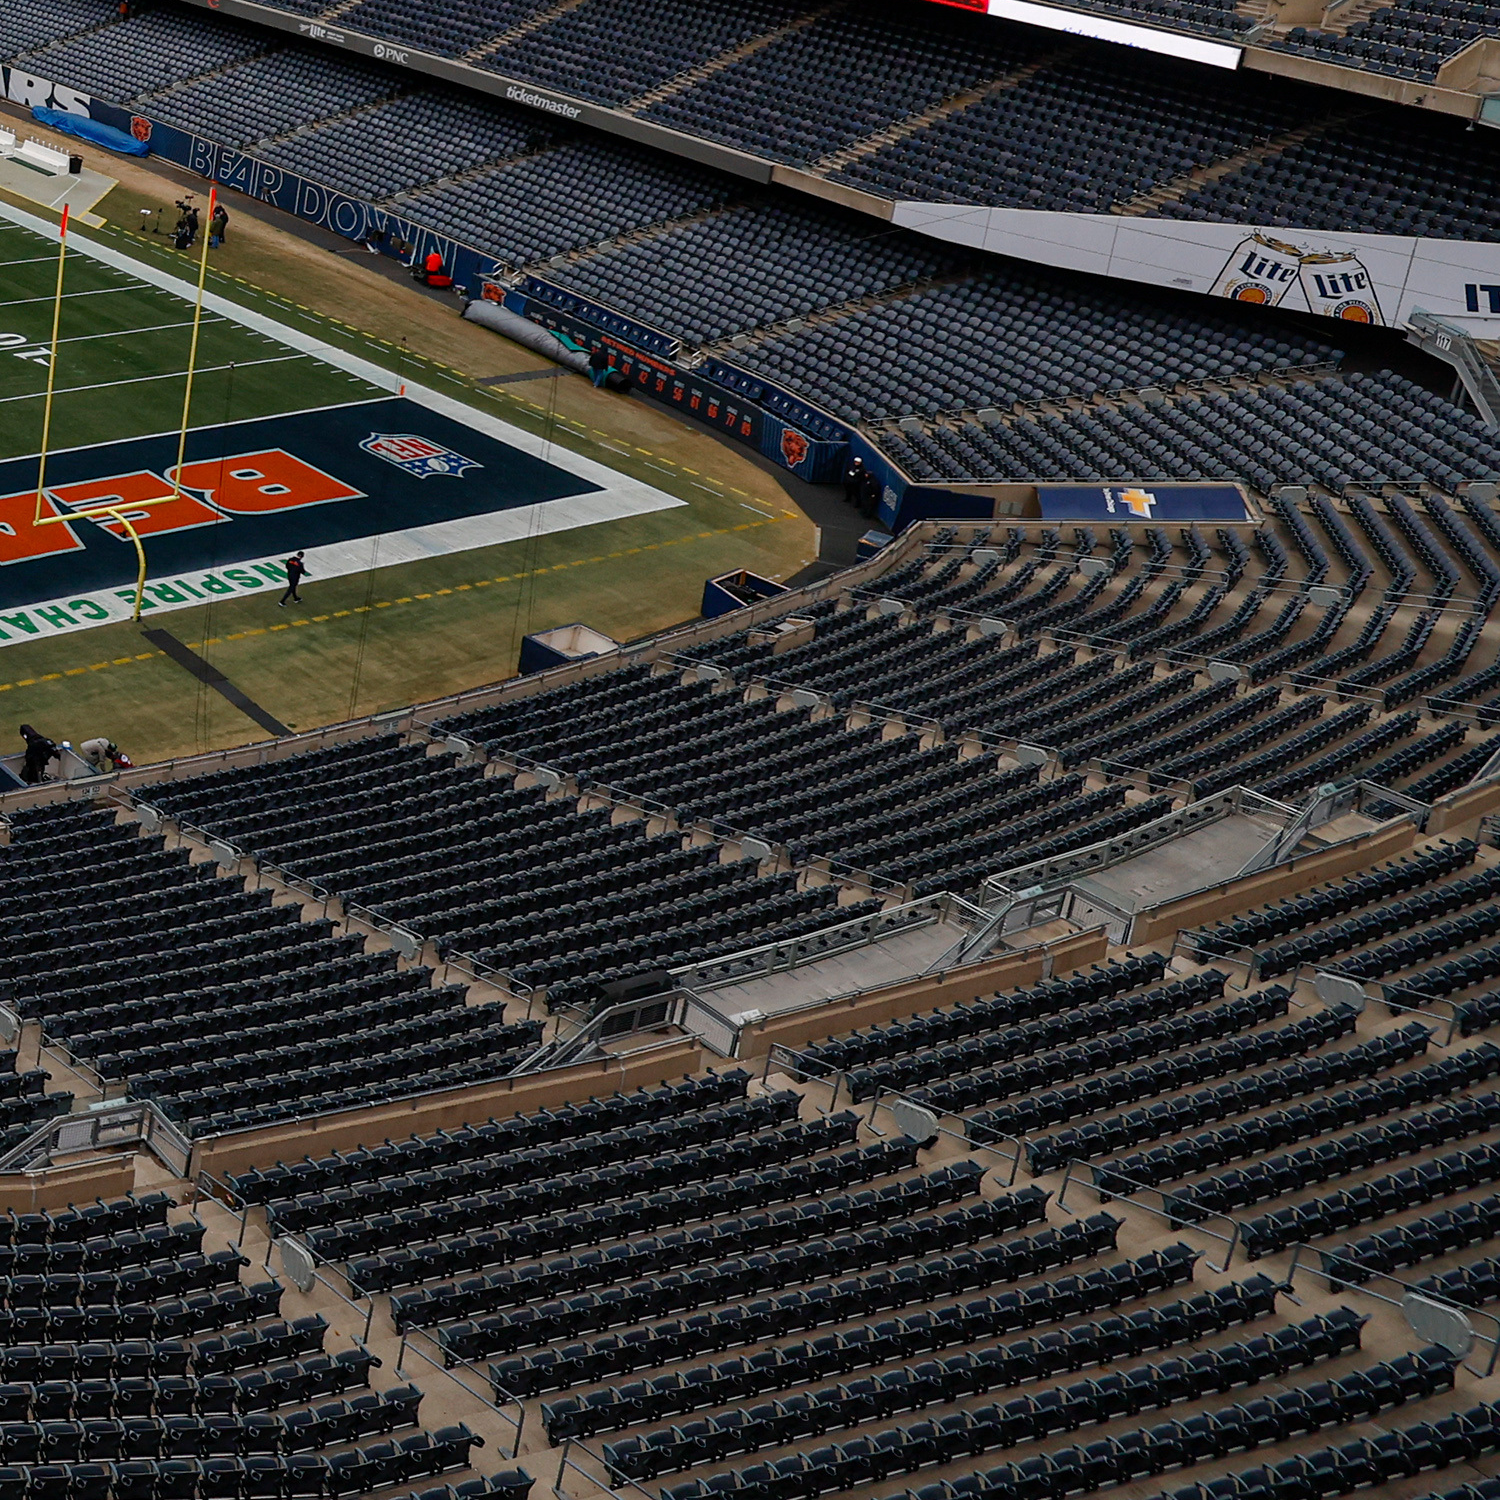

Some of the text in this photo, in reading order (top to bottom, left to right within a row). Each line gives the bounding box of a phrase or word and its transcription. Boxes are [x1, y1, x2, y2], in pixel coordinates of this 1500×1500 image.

[309, 23, 326, 39] Lite
[386, 50, 409, 65] PNC
[506, 85, 582, 120] ticketmaster
[188, 134, 458, 280] BEAR DOWN
[1239, 251, 1298, 283] Lite
[1312, 269, 1368, 299] Lite
[1437, 334, 1451, 348] 117
[600, 335, 677, 376] RETIRED NUMBERS
[725, 412, 737, 427] 77
[369, 438, 444, 460] NFL
